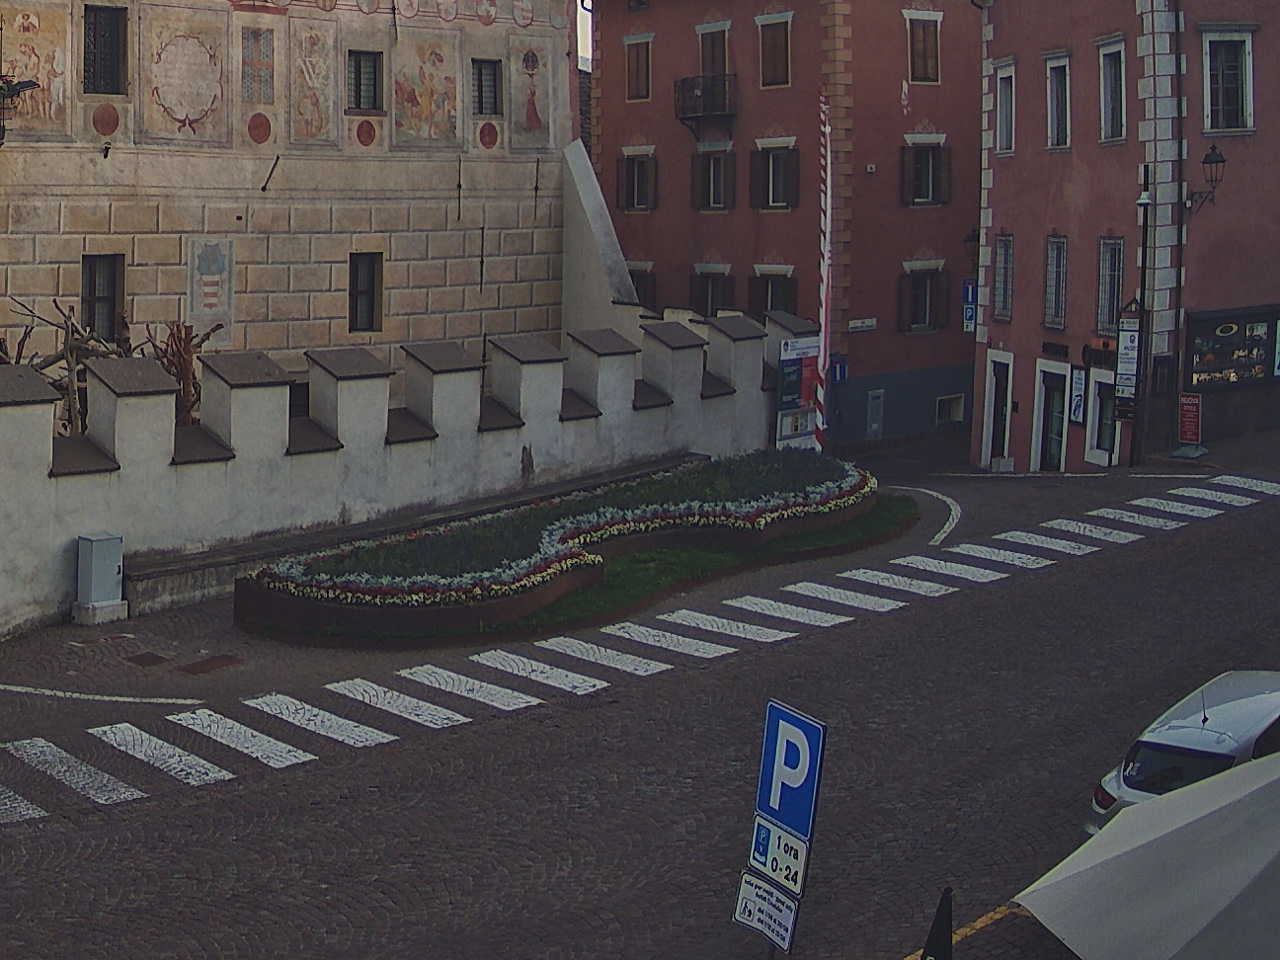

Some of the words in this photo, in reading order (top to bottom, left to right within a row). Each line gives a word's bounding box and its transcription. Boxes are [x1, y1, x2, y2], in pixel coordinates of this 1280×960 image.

[769, 719, 810, 811] P
[775, 834, 782, 851] 1
[783, 842, 800, 862] ora
